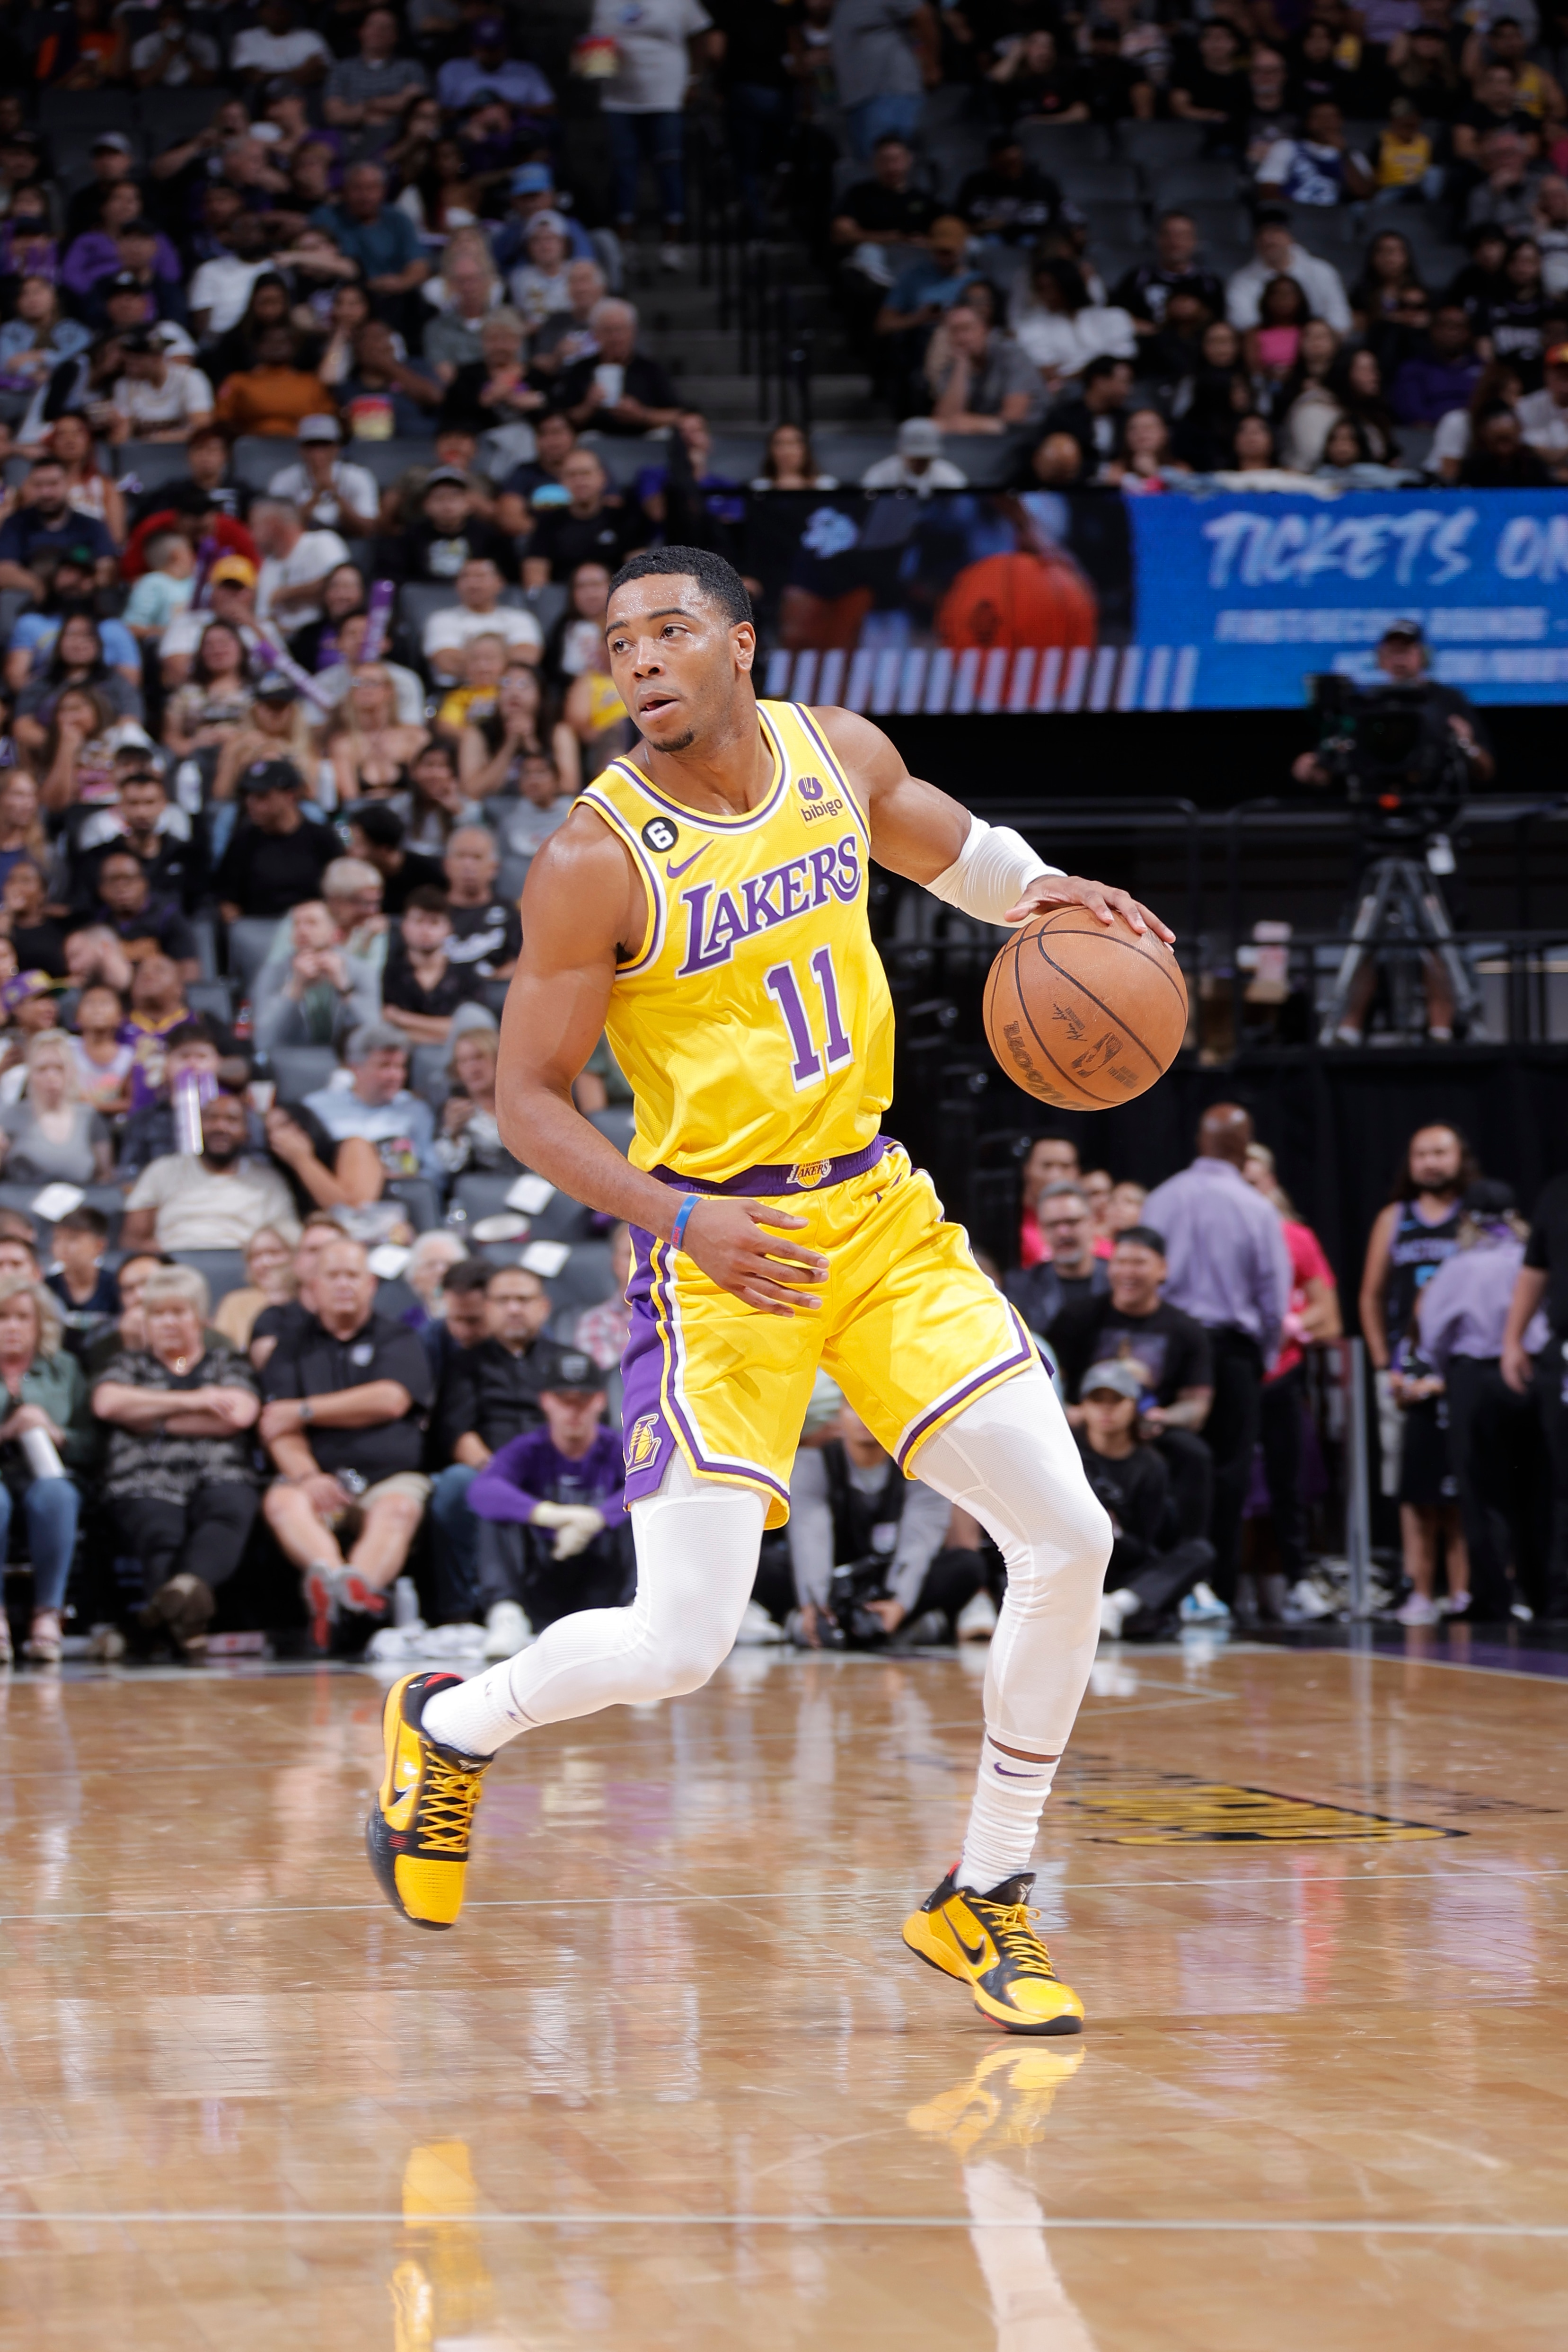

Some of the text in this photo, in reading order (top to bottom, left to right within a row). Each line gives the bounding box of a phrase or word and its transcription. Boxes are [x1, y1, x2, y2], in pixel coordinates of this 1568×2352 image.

[1203, 508, 1478, 588] TICKETS
[646, 822, 674, 849] 6
[801, 799, 843, 822] bibigo
[676, 834, 861, 979] LAKERS
[763, 943, 855, 1094] 11
[786, 1163, 831, 1183] LAKERS
